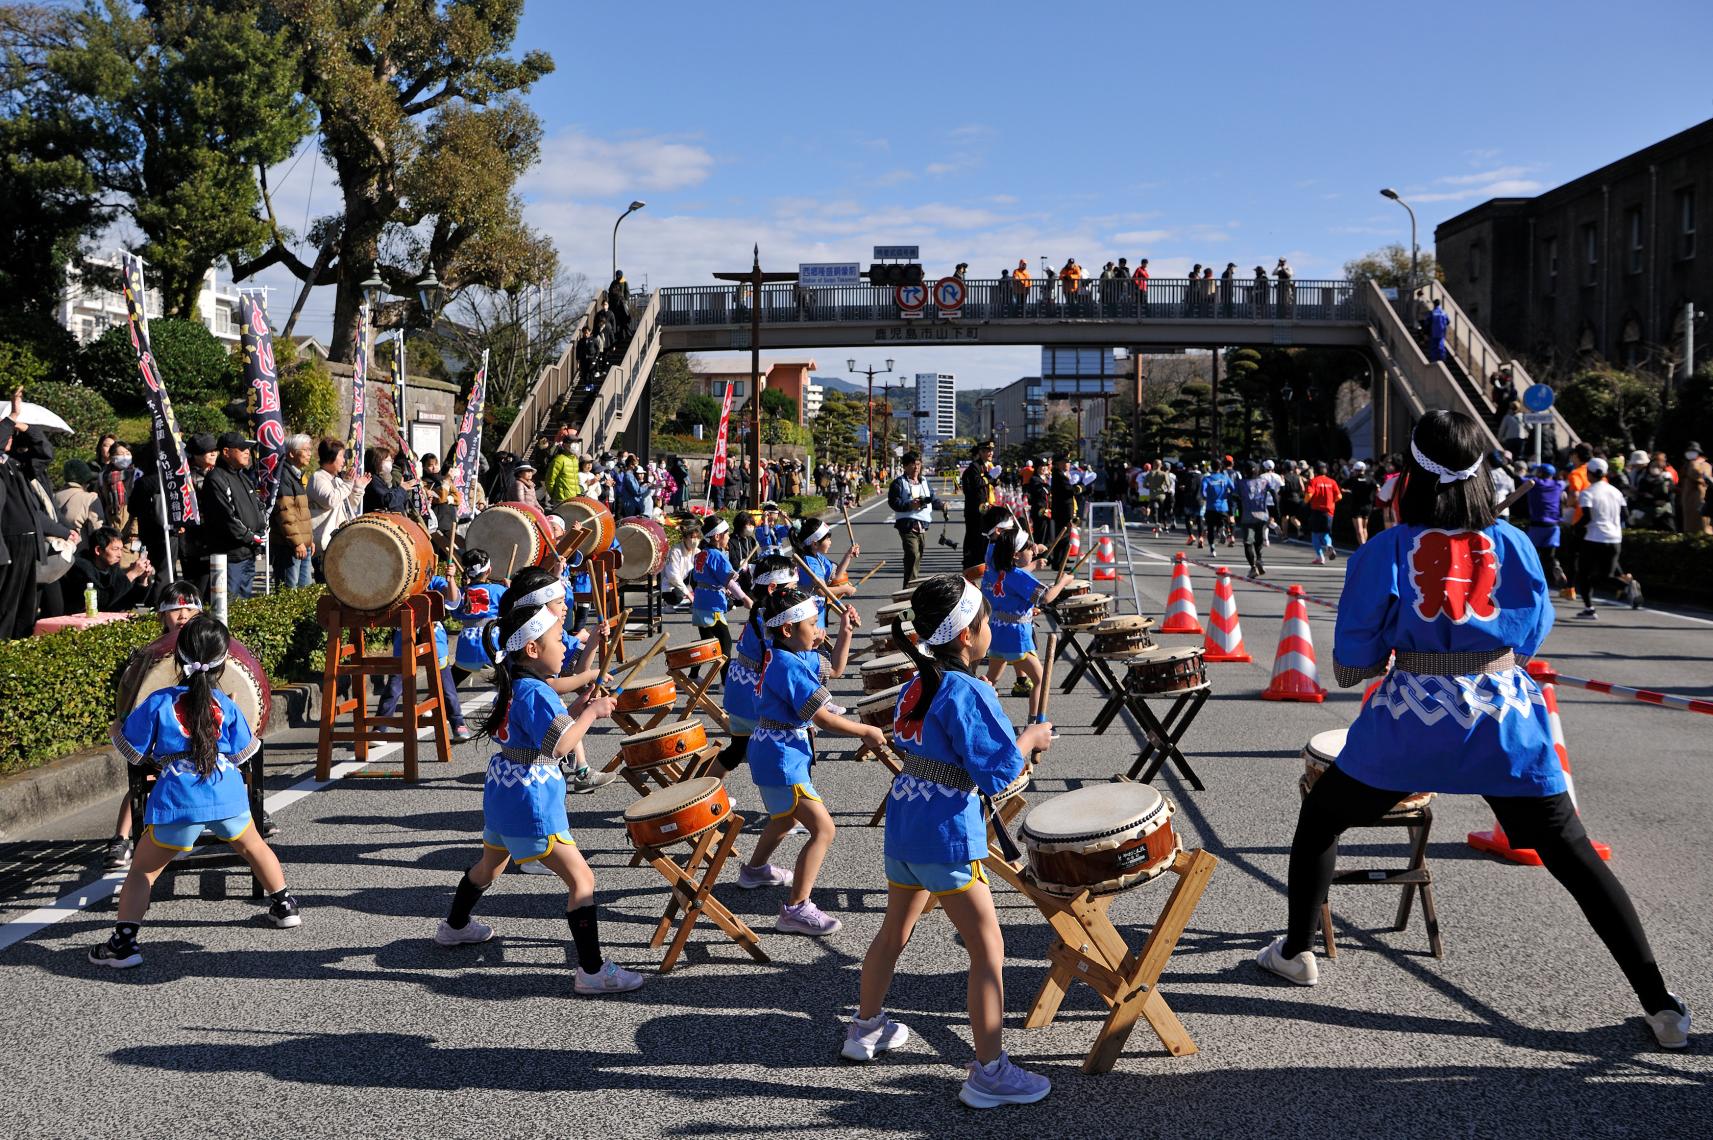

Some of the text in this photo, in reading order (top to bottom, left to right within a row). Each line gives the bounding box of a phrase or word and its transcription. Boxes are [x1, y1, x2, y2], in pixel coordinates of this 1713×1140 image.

[875, 327, 979, 340] 鹿児島市山下町
[159, 450, 182, 521] あけぼの幼稚園
